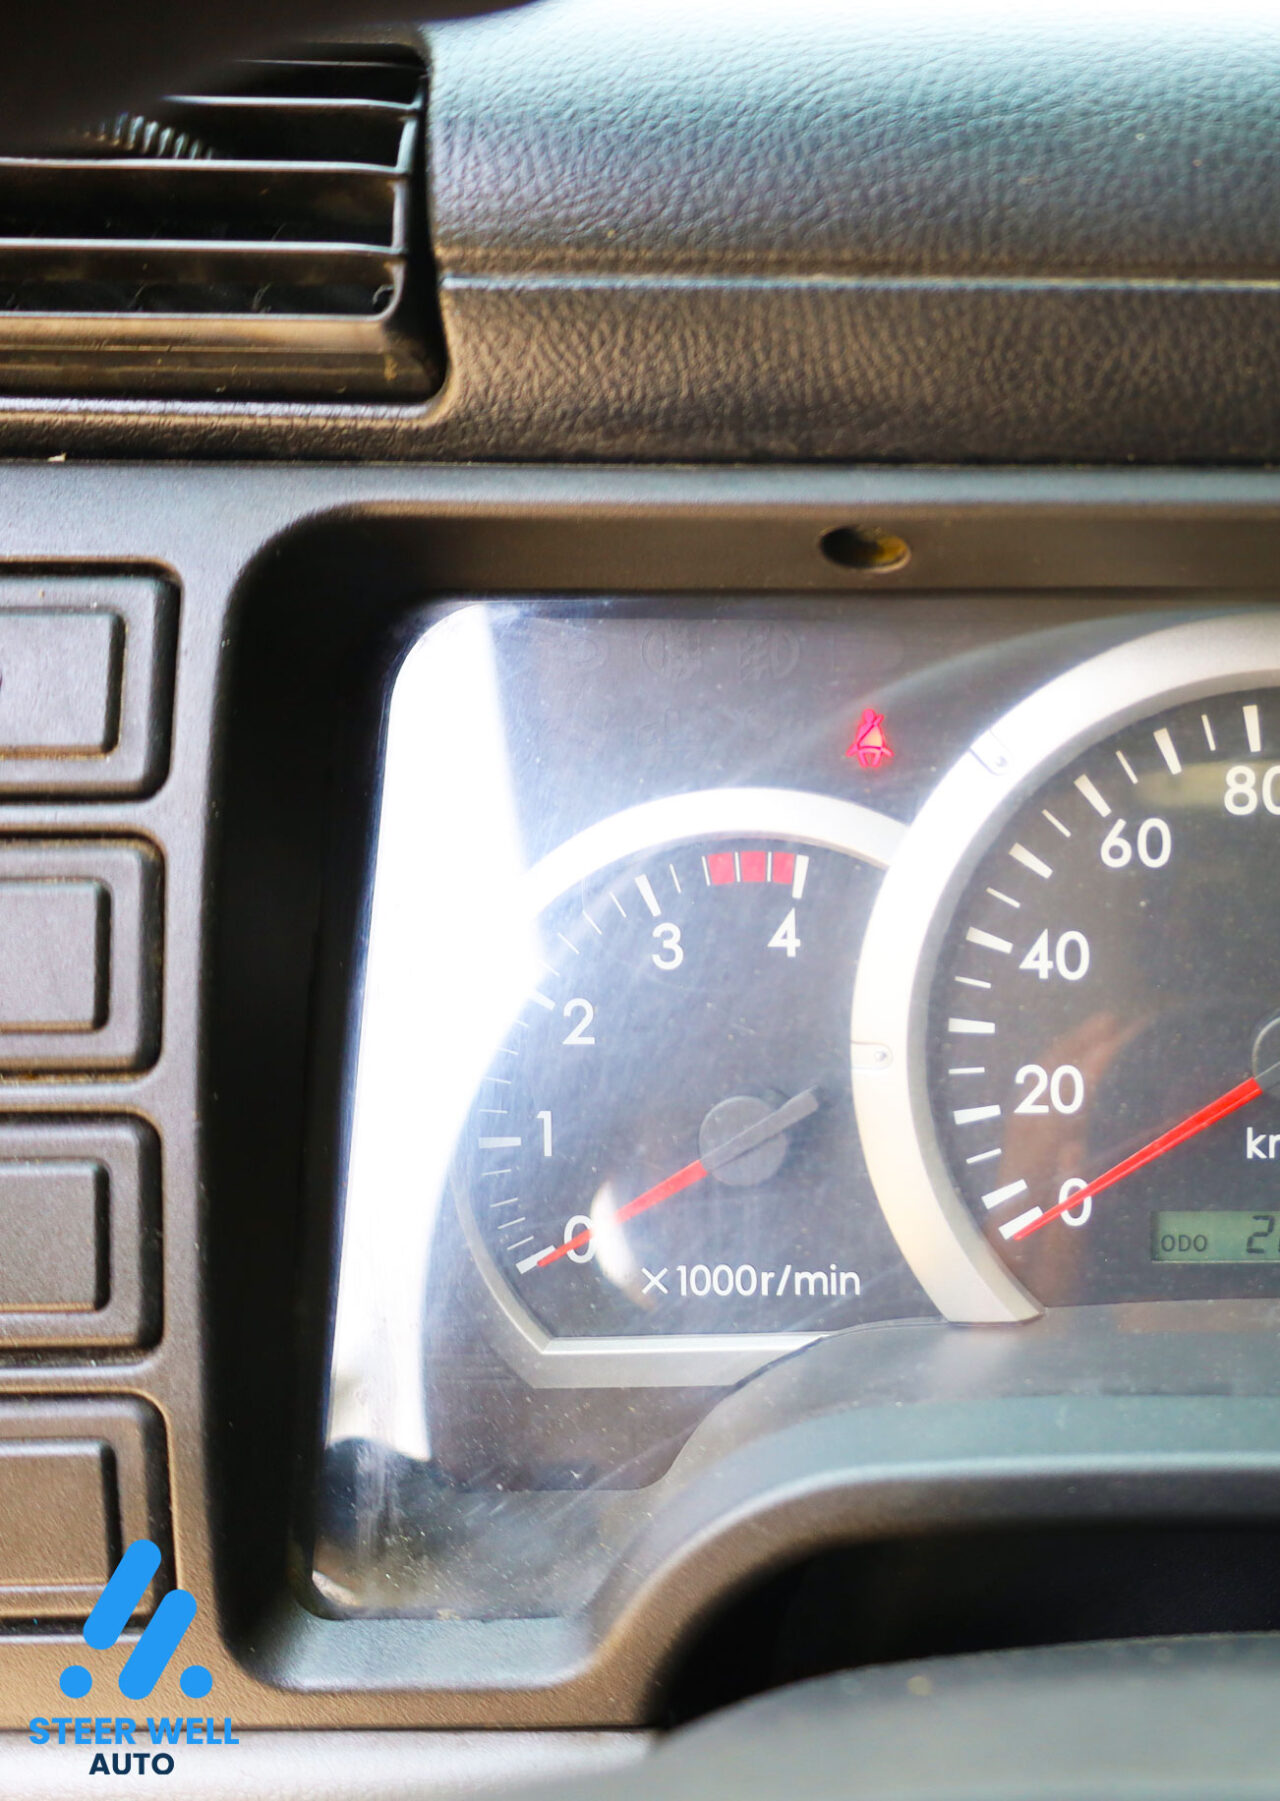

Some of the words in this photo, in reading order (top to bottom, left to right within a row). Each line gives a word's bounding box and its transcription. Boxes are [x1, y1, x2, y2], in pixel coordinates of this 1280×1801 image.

[1100, 818, 1172, 869] 60
[651, 922, 684, 970] 3
[767, 907, 801, 958] 4
[1019, 930, 1090, 980] 40
[562, 998, 596, 1045] 2
[1014, 1065, 1084, 1114] 20
[536, 1110, 553, 1157] 1
[1058, 1177, 1093, 1227] 0
[563, 1215, 598, 1264] 0
[1160, 1233, 1208, 1253] ODO
